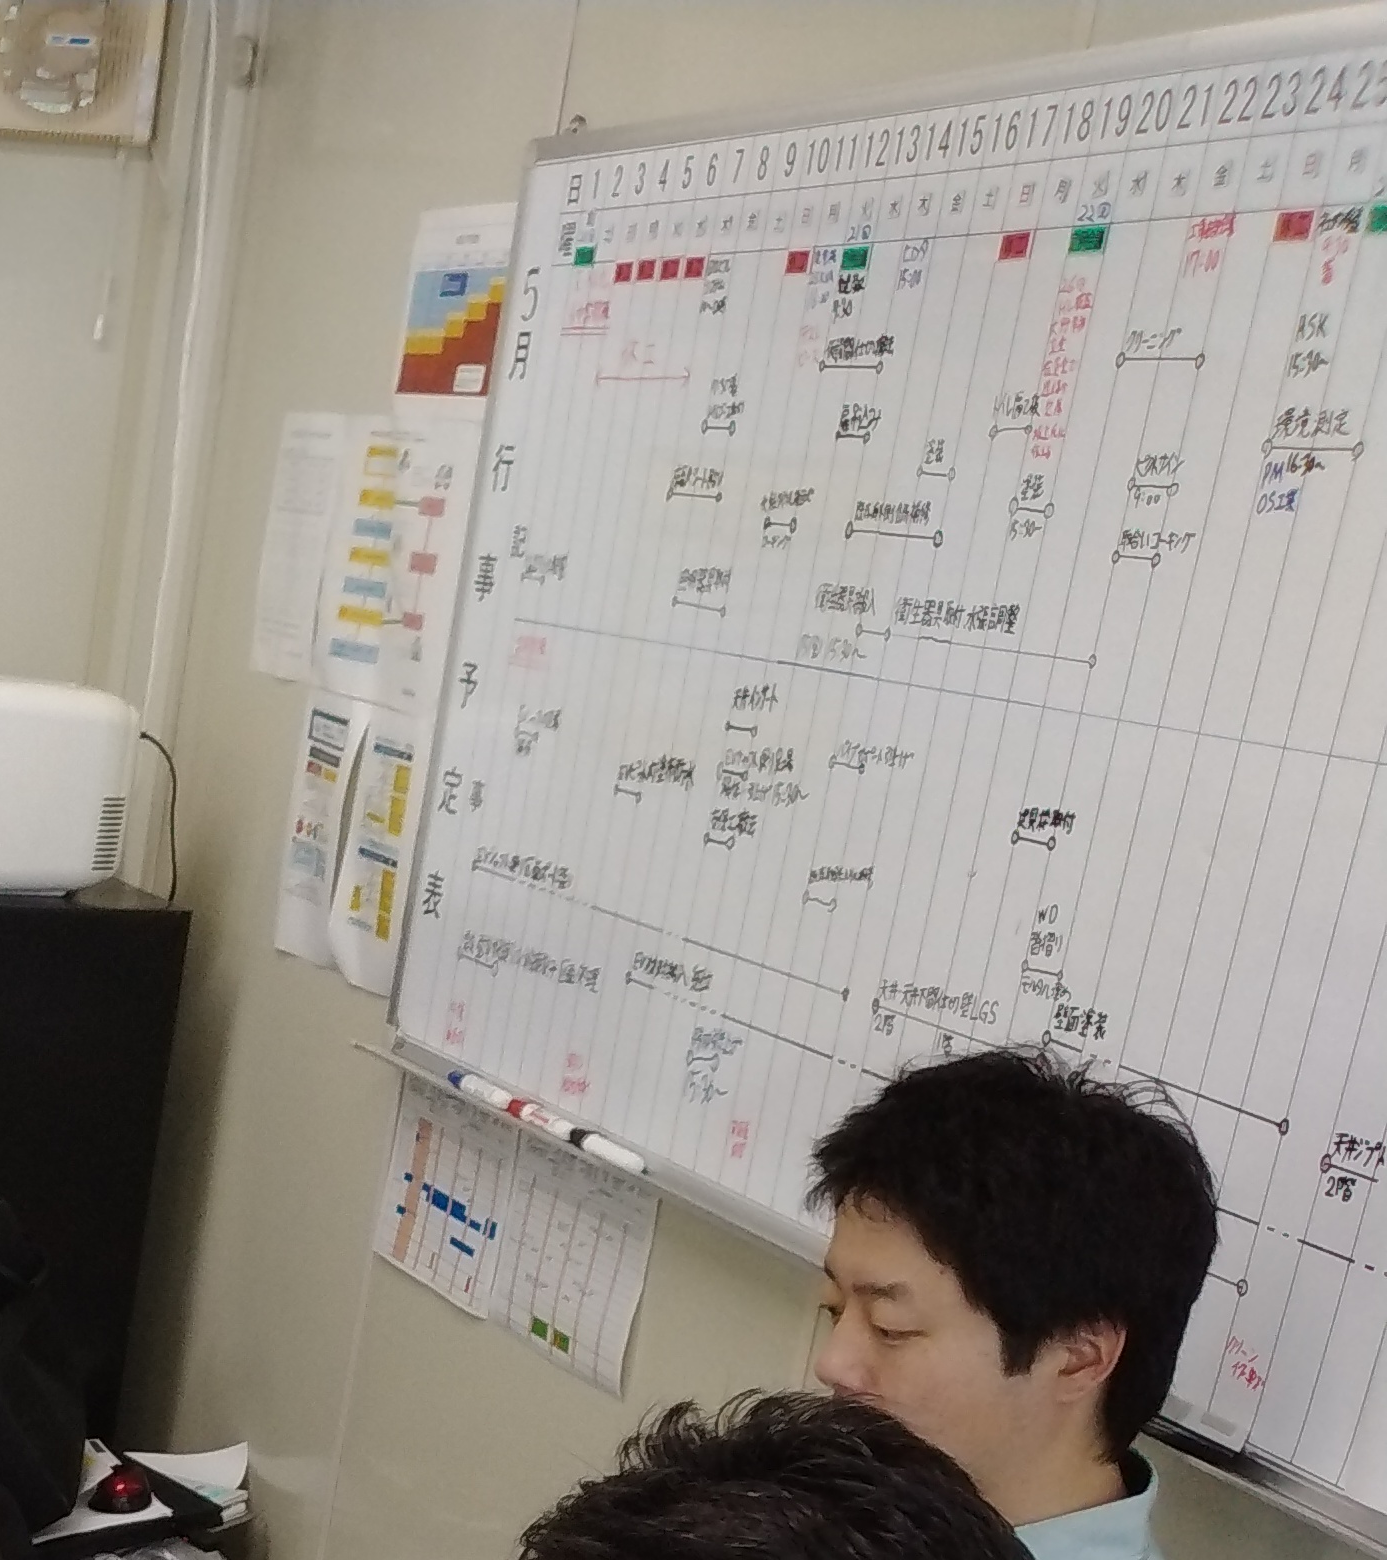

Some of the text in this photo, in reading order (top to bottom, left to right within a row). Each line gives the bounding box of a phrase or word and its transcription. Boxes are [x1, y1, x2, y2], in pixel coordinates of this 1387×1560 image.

[567, 174, 583, 206] 日
[592, 169, 601, 199] 1
[611, 165, 623, 198] 2
[634, 162, 647, 195] 3
[657, 159, 670, 192] 4
[681, 155, 695, 189] 5
[706, 153, 718, 187] 6
[731, 148, 745, 183] 7
[757, 145, 770, 180] 8
[784, 142, 797, 177] 9
[807, 137, 830, 176] 10
[835, 134, 858, 172] 11
[865, 129, 890, 168] 12
[895, 125, 920, 165] 13
[927, 121, 951, 161] 14
[956, 116, 984, 157] 15
[992, 111, 1019, 153] 16
[1027, 105, 1059, 148] 17
[1063, 100, 1094, 144] 18
[1100, 94, 1132, 140] 19
[1135, 89, 1171, 135] 20
[1177, 83, 1215, 130] 21
[1218, 77, 1258, 125] 22
[1261, 71, 1302, 120] 23
[1304, 64, 1346, 115] 24
